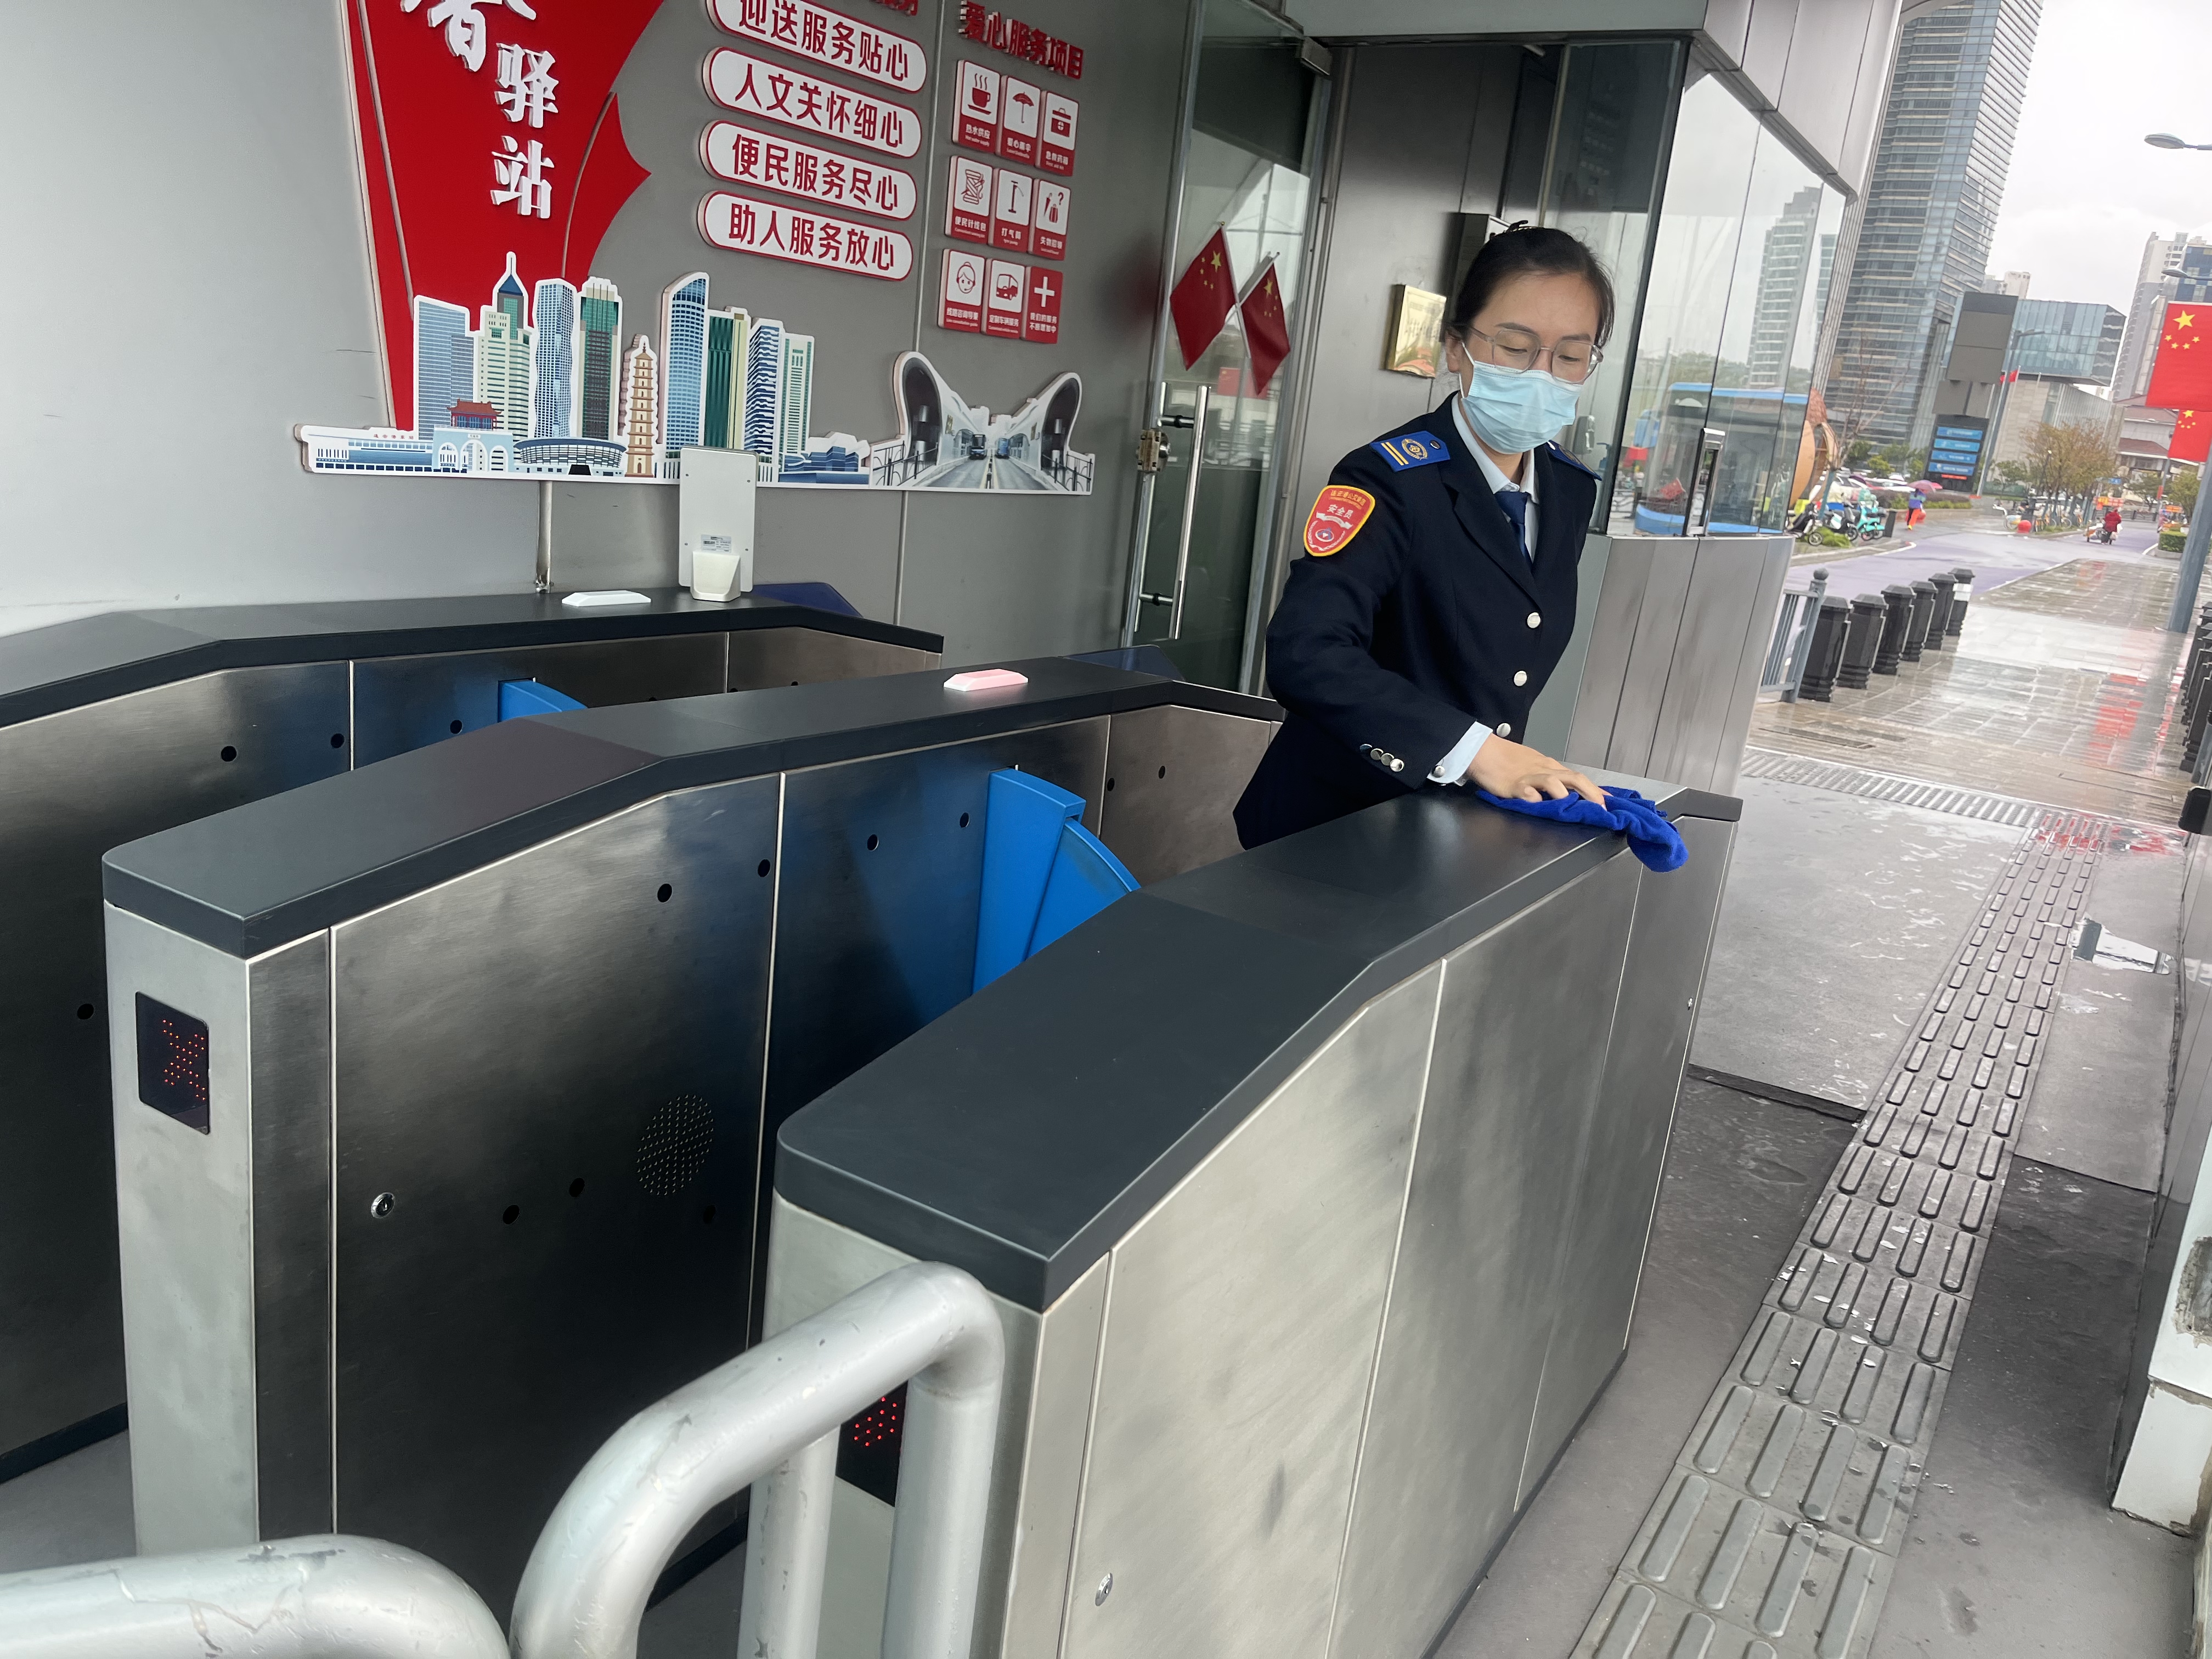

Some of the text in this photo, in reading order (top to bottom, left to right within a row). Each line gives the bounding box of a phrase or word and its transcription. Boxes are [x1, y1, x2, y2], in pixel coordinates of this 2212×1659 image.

[739, 0, 908, 81] 迎送服务贴心
[960, 1, 1084, 80] 爱心服务项目
[490, 43, 558, 219] 驿站
[735, 64, 903, 148] 人文关怀细心
[732, 134, 898, 211] 便民服务尽心
[729, 203, 894, 270] 助人服务放心
[1327, 505, 1353, 519] 安全员
